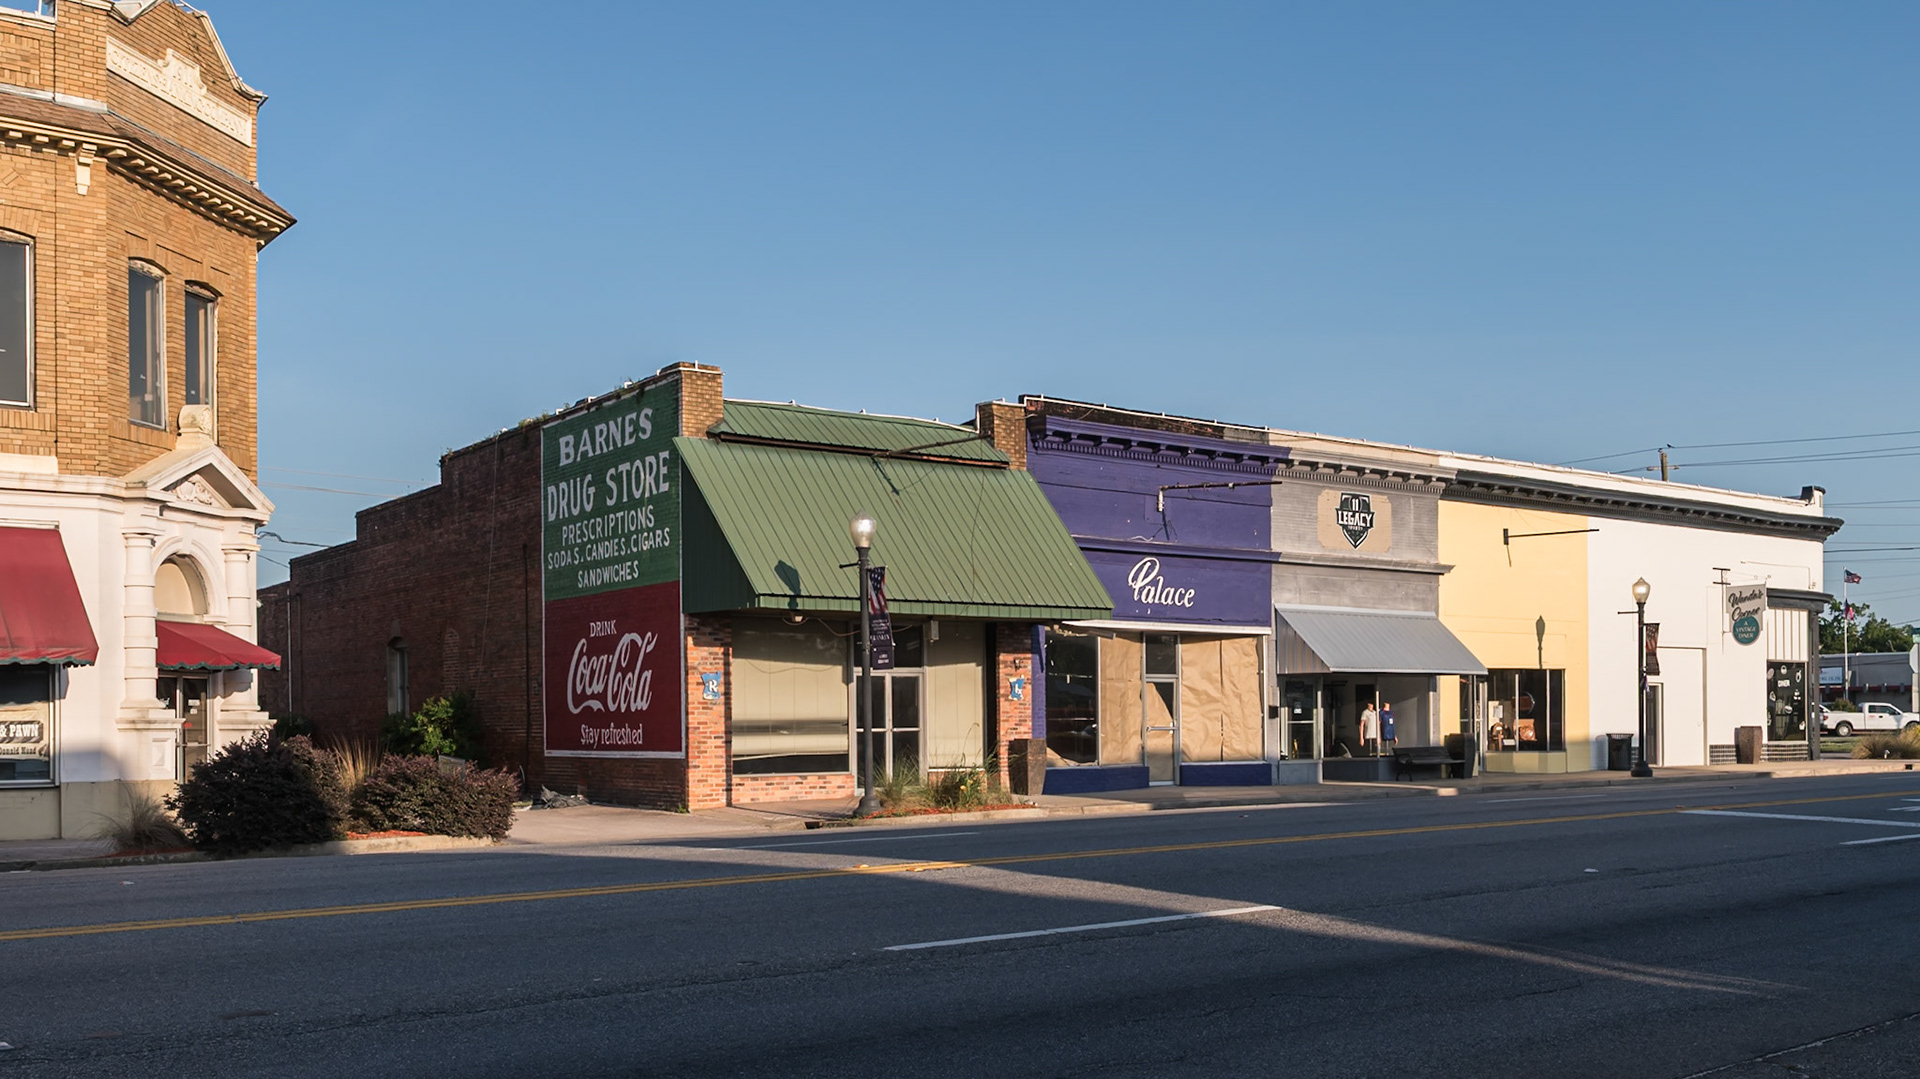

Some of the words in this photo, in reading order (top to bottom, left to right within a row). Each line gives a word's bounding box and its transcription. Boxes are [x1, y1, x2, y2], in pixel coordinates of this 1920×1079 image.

[559, 408, 653, 467] BARNES
[547, 473, 596, 521] DRUG
[606, 450, 670, 506] STORE
[562, 504, 655, 547] PRESCRIPTIONS
[1338, 511, 1372, 527] LEGACY
[630, 527, 671, 553] CIGARS
[577, 560, 640, 588] SANDWICHES
[1127, 556, 1195, 608] Palace
[590, 620, 617, 637] DRINK
[567, 631, 658, 714] Coca-Cola
[9, 724, 39, 737] PAWN
[580, 723, 600, 749] Stay
[601, 721, 643, 745] refreshed
